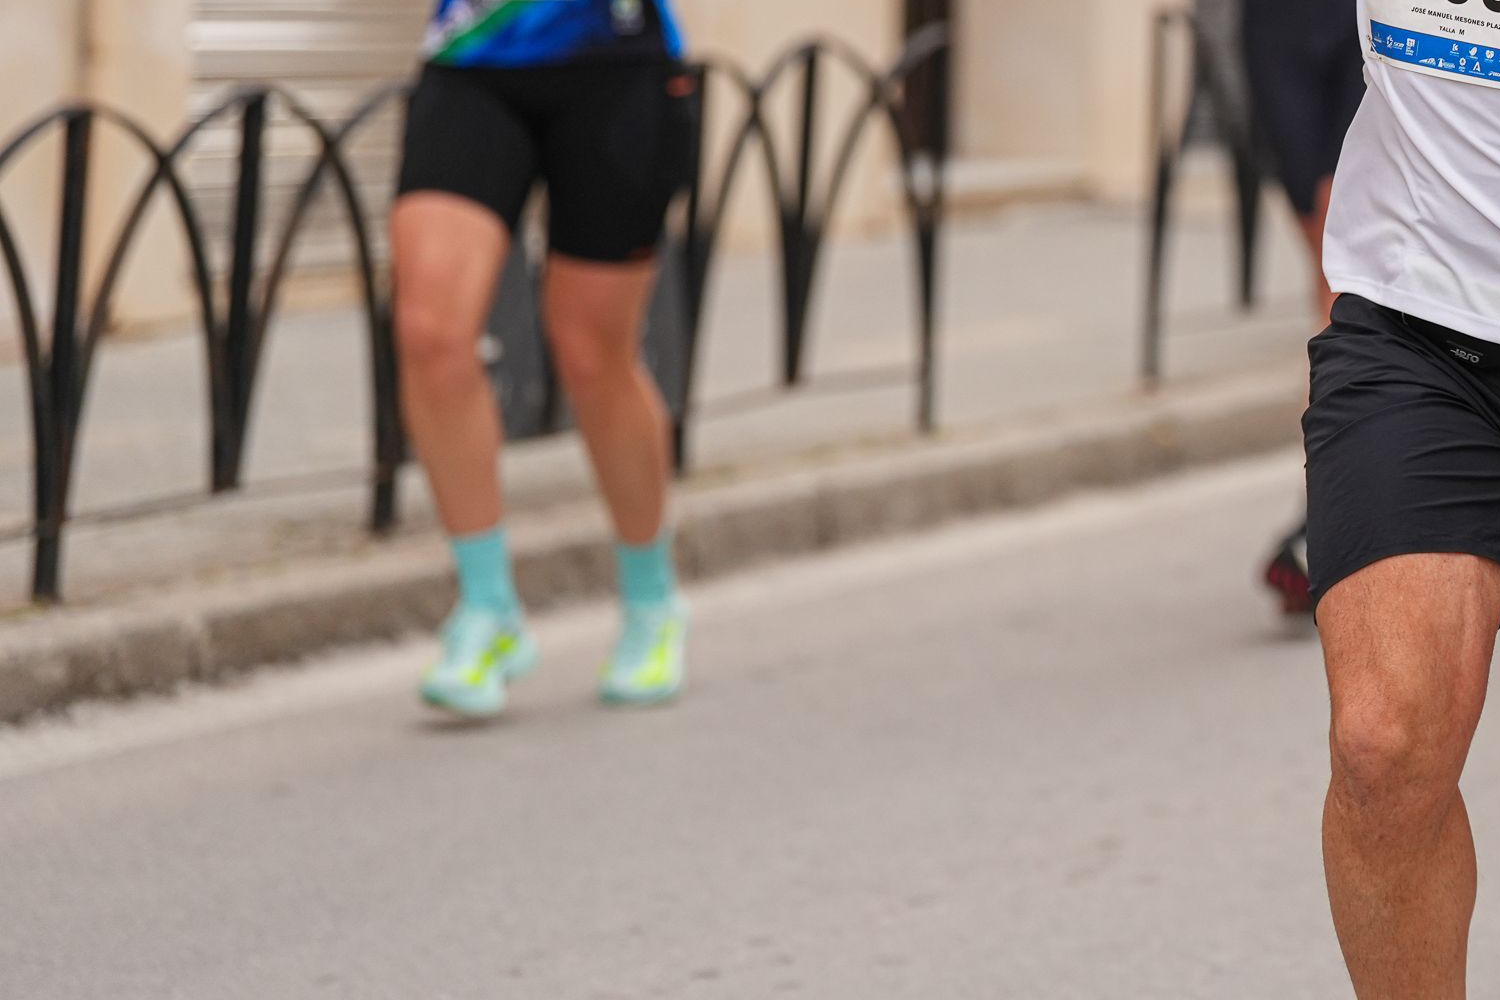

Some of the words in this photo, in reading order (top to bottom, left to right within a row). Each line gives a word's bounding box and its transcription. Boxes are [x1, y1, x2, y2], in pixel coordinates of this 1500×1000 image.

[1427, 10, 1453, 21] MANUEL
[1454, 15, 1485, 27] MESONES
[1439, 25, 1456, 34] TALLA
